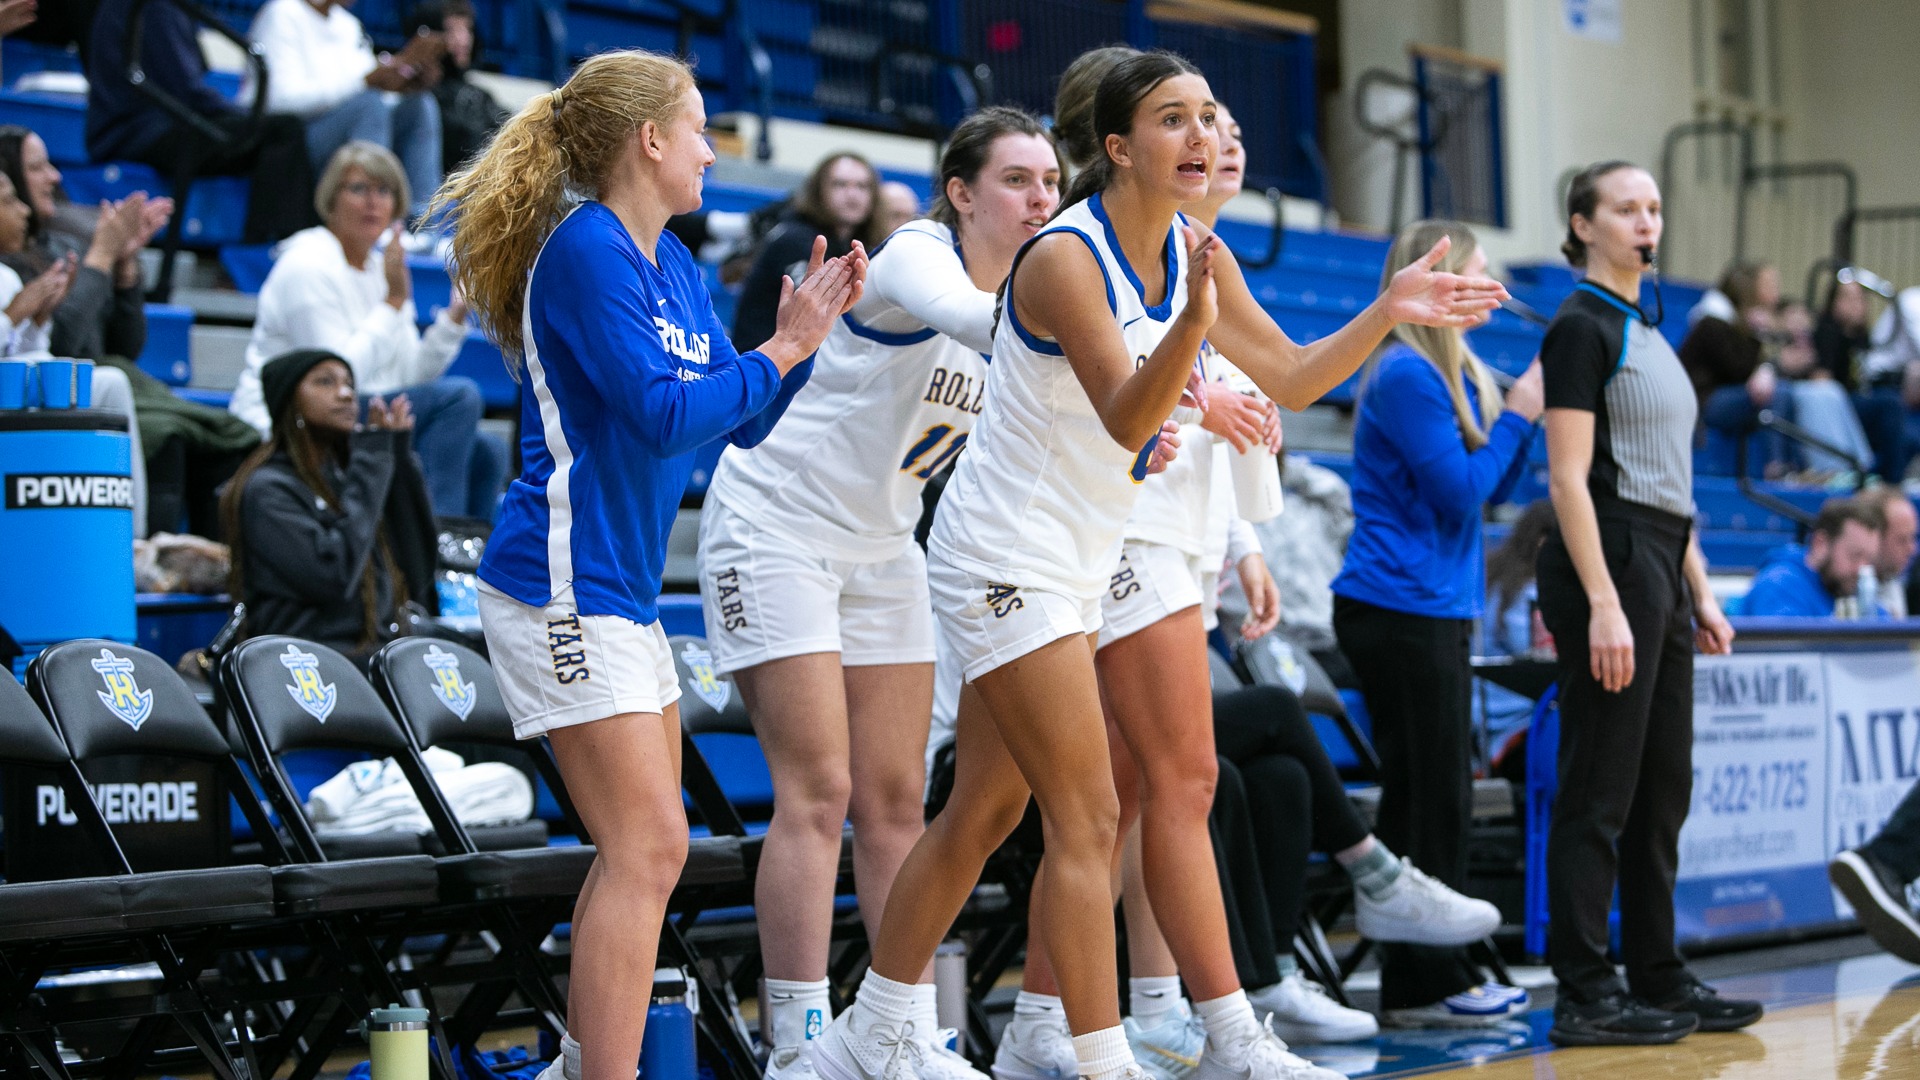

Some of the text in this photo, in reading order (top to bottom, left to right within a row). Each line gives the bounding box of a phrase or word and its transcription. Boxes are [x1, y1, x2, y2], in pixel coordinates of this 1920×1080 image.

[716, 565, 748, 632] TARS
[1109, 549, 1142, 601] RS
[547, 612, 591, 686] TARS
